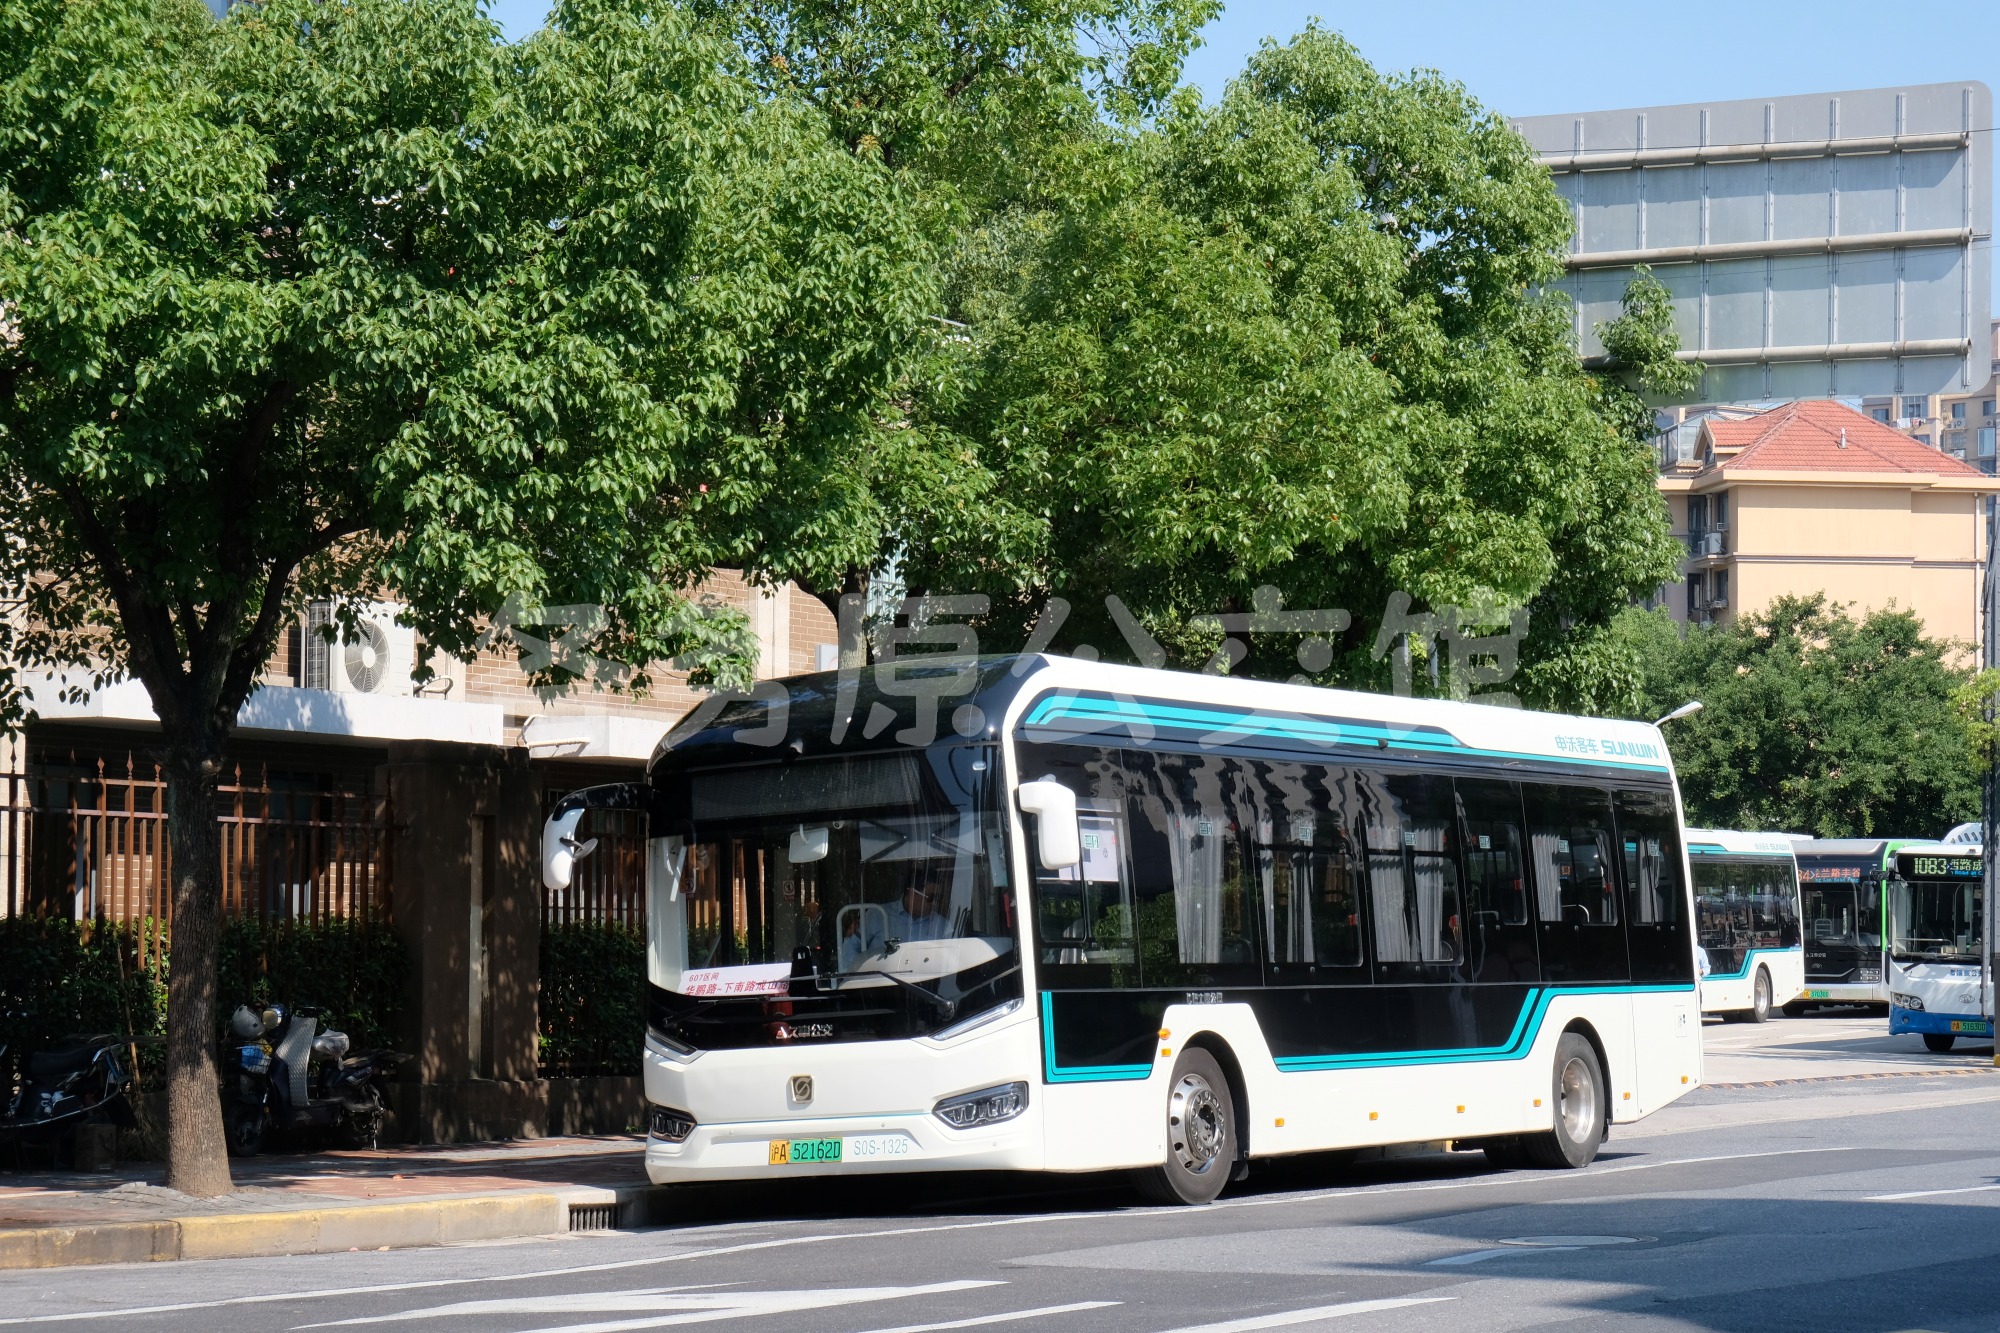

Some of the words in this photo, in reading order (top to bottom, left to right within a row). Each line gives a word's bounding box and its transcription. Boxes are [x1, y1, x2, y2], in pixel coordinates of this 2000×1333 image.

[1554, 735, 1599, 754] 申沃客车
[1601, 740, 1659, 759] SUNWIN
[1913, 857, 1947, 875] 1083
